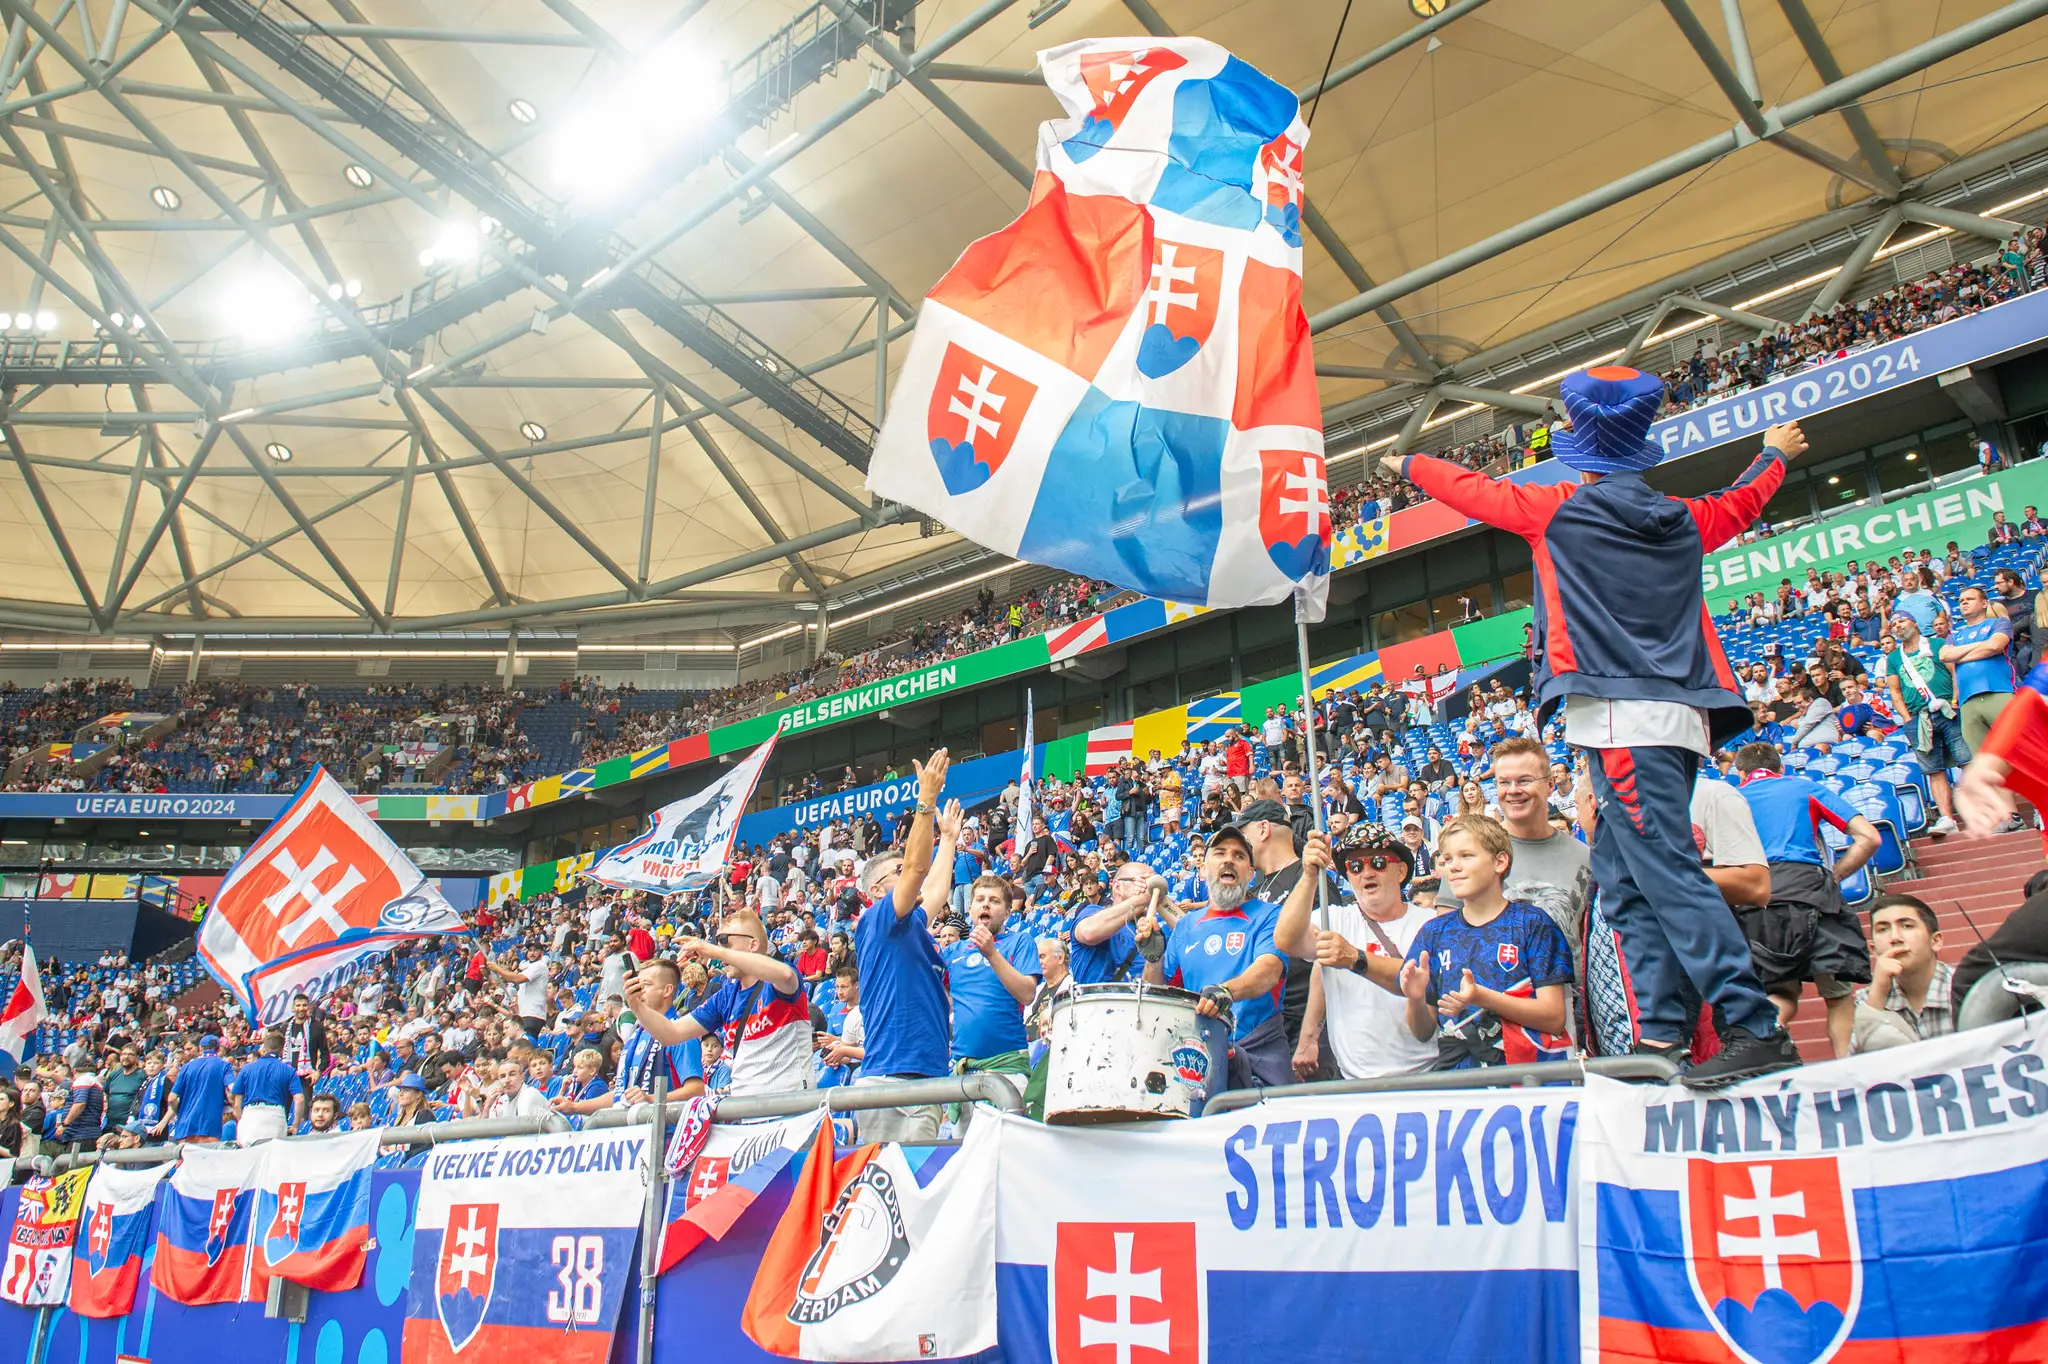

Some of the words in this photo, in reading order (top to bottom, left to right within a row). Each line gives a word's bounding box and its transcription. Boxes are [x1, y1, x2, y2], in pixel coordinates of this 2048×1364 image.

[1702, 482, 2005, 592] SENKIRCHEN
[778, 665, 956, 732] GELSENKIRCHEN
[1644, 1078, 1800, 1154] MALÝ
[1813, 1040, 2048, 1150] HOREŠ
[432, 1144, 500, 1180] VEĽKÉ
[498, 1139, 645, 1177] KOSTOĽANY
[1224, 1101, 1580, 1231] STROPKOV
[547, 1235, 604, 1324] 38
[790, 1273, 883, 1322] TERDAM
